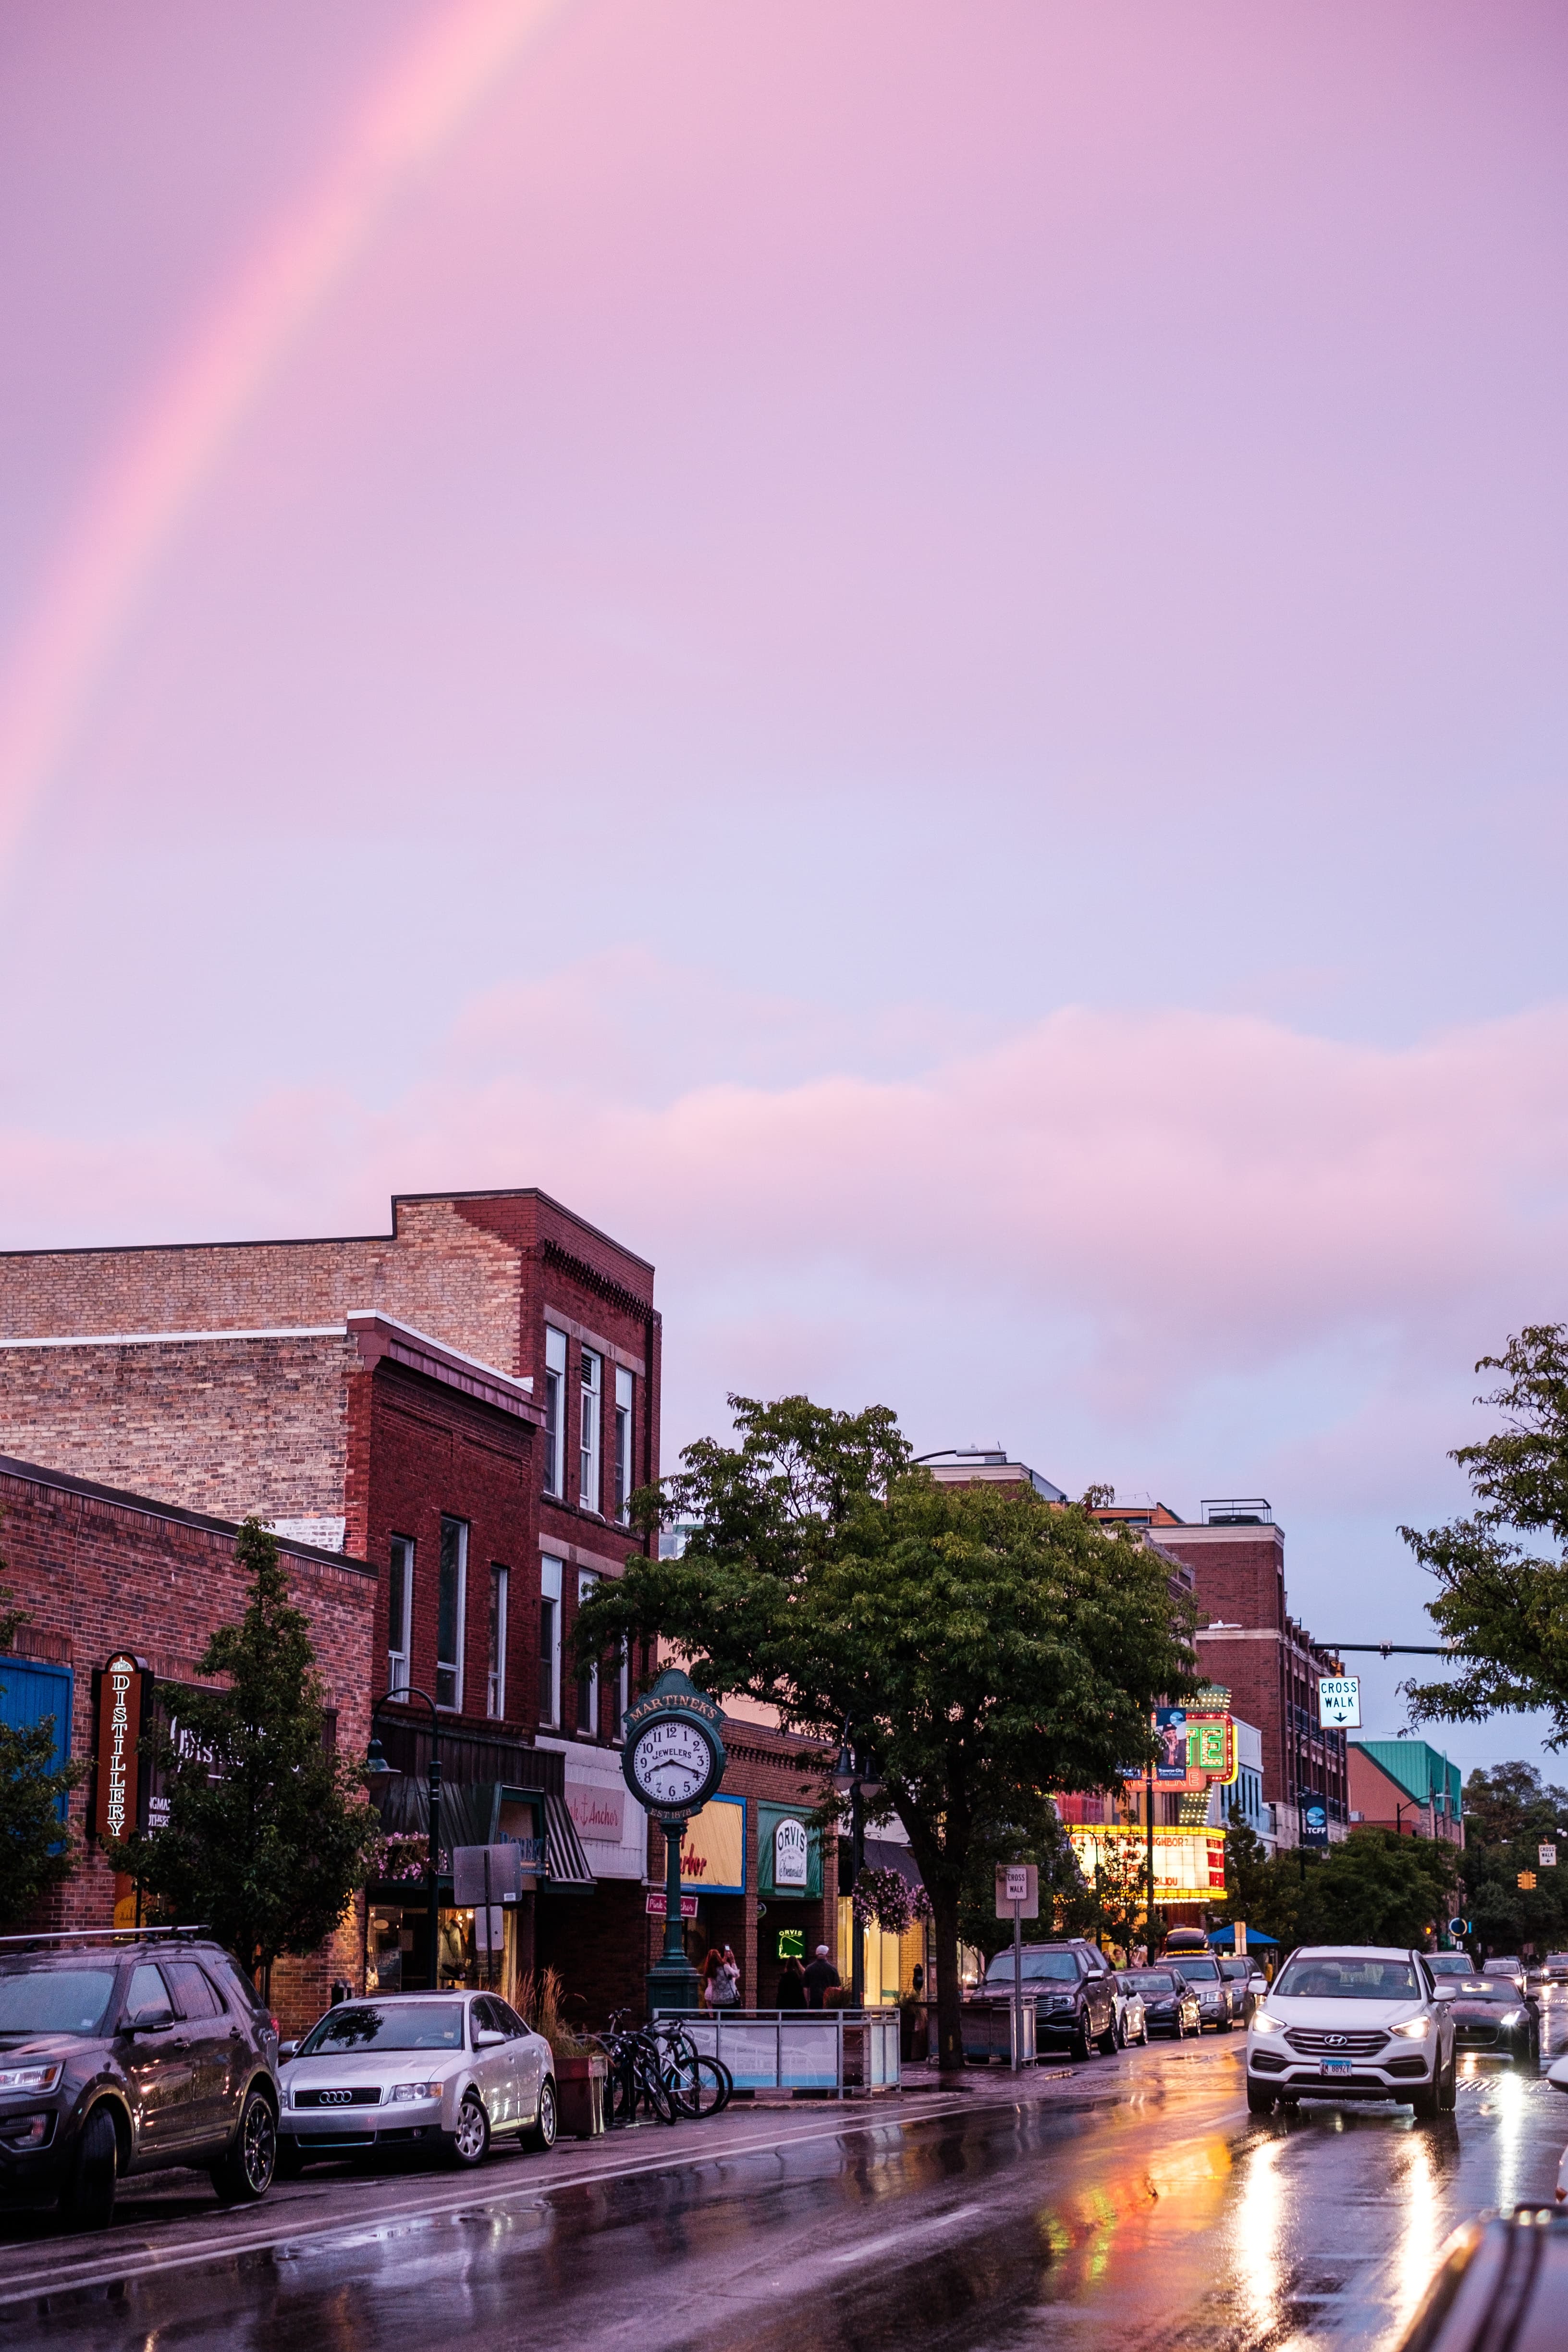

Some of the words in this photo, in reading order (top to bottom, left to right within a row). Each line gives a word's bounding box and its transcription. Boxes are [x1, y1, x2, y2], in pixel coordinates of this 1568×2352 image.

[1321, 1682, 1357, 1693] CROSS
[1325, 1697, 1354, 1708] WALK
[630, 1695, 718, 1722] MARTINEK'S
[653, 1732, 661, 1742] 11
[666, 1727, 677, 1738] 12
[684, 1730, 687, 1741] 1
[643, 1743, 653, 1753] 10
[693, 1740, 700, 1752] 2
[107, 1675, 130, 1836] DISTILLERY
[652, 1749, 692, 1760] JEWELERS
[640, 1758, 647, 1768] 9
[697, 1755, 704, 1766] 3
[644, 1772, 651, 1783] 8
[693, 1771, 700, 1781] 4
[669, 1786, 675, 1797] 6
[683, 1781, 690, 1792] 5
[672, 1808, 692, 1819] 1878
[778, 1826, 805, 1852] ORVIS
[649, 1899, 662, 1909] Pink
